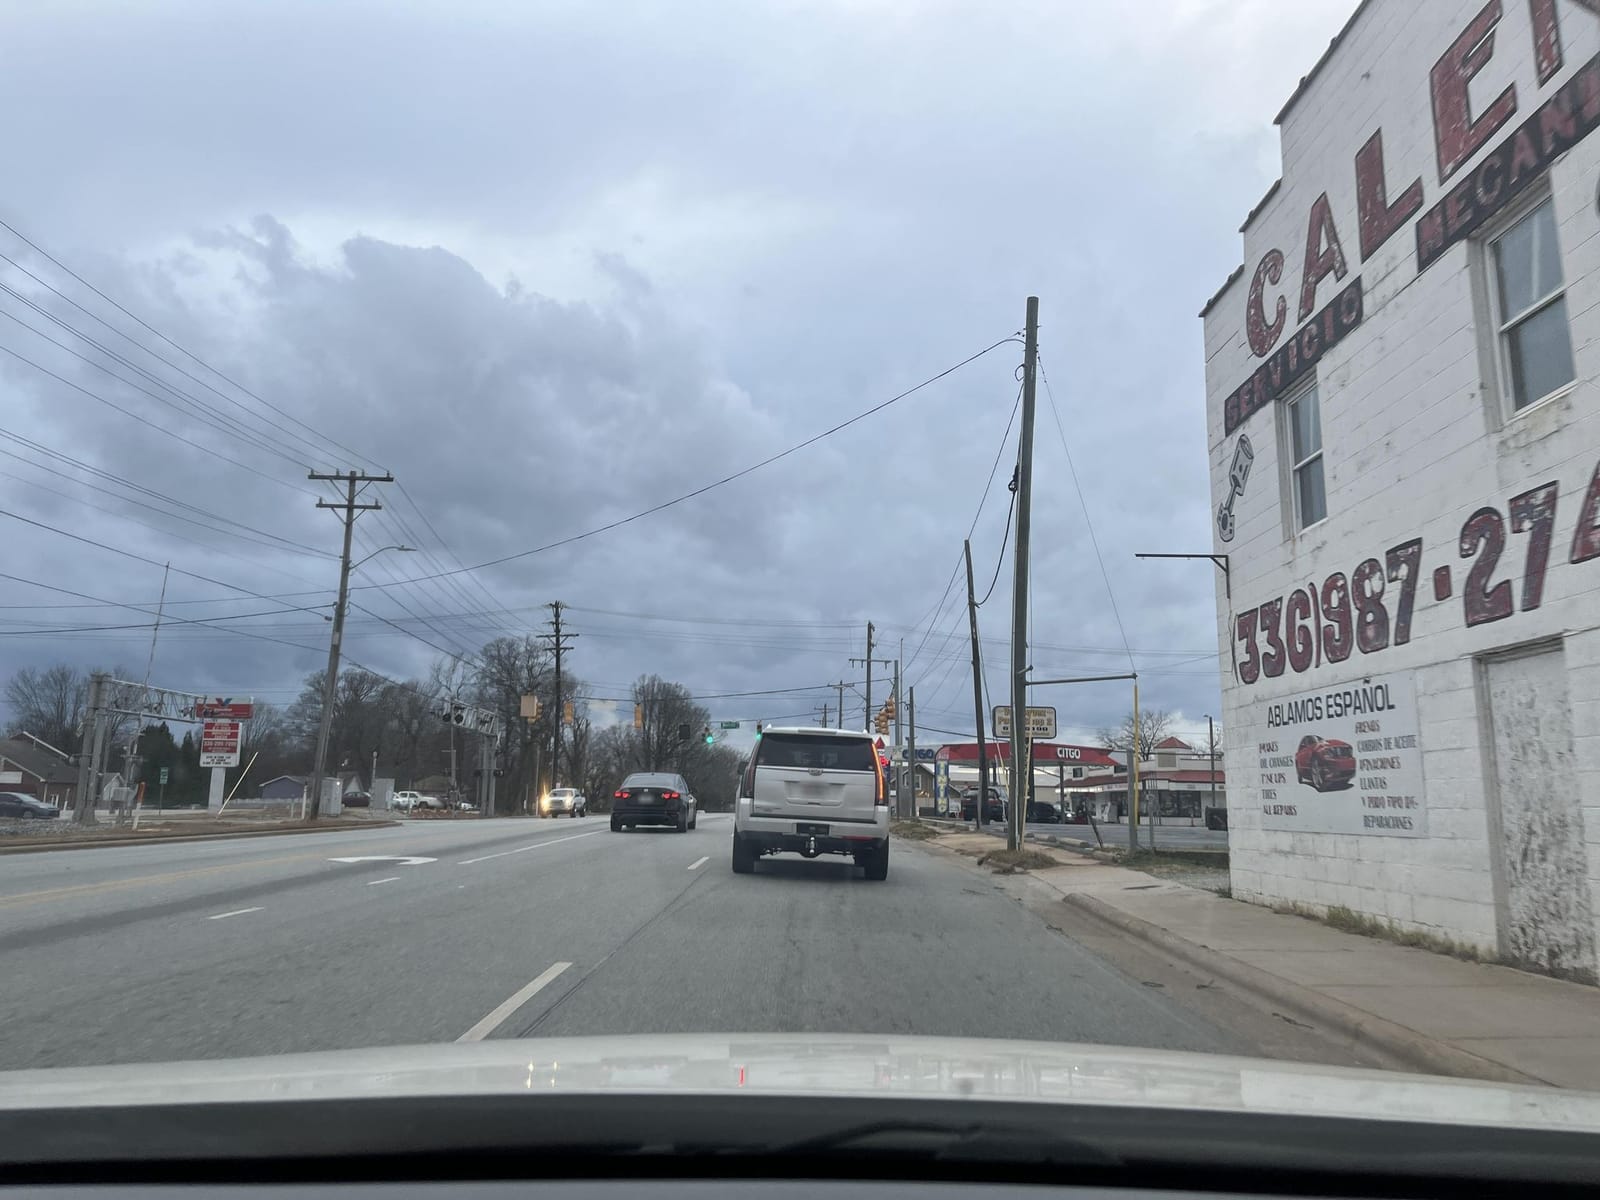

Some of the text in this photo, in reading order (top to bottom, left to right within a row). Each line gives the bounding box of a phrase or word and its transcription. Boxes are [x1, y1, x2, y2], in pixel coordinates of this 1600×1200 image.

[1267, 678, 1396, 728] ABLAMOS ESPAÑOL
[1056, 747, 1081, 760] CITGO
